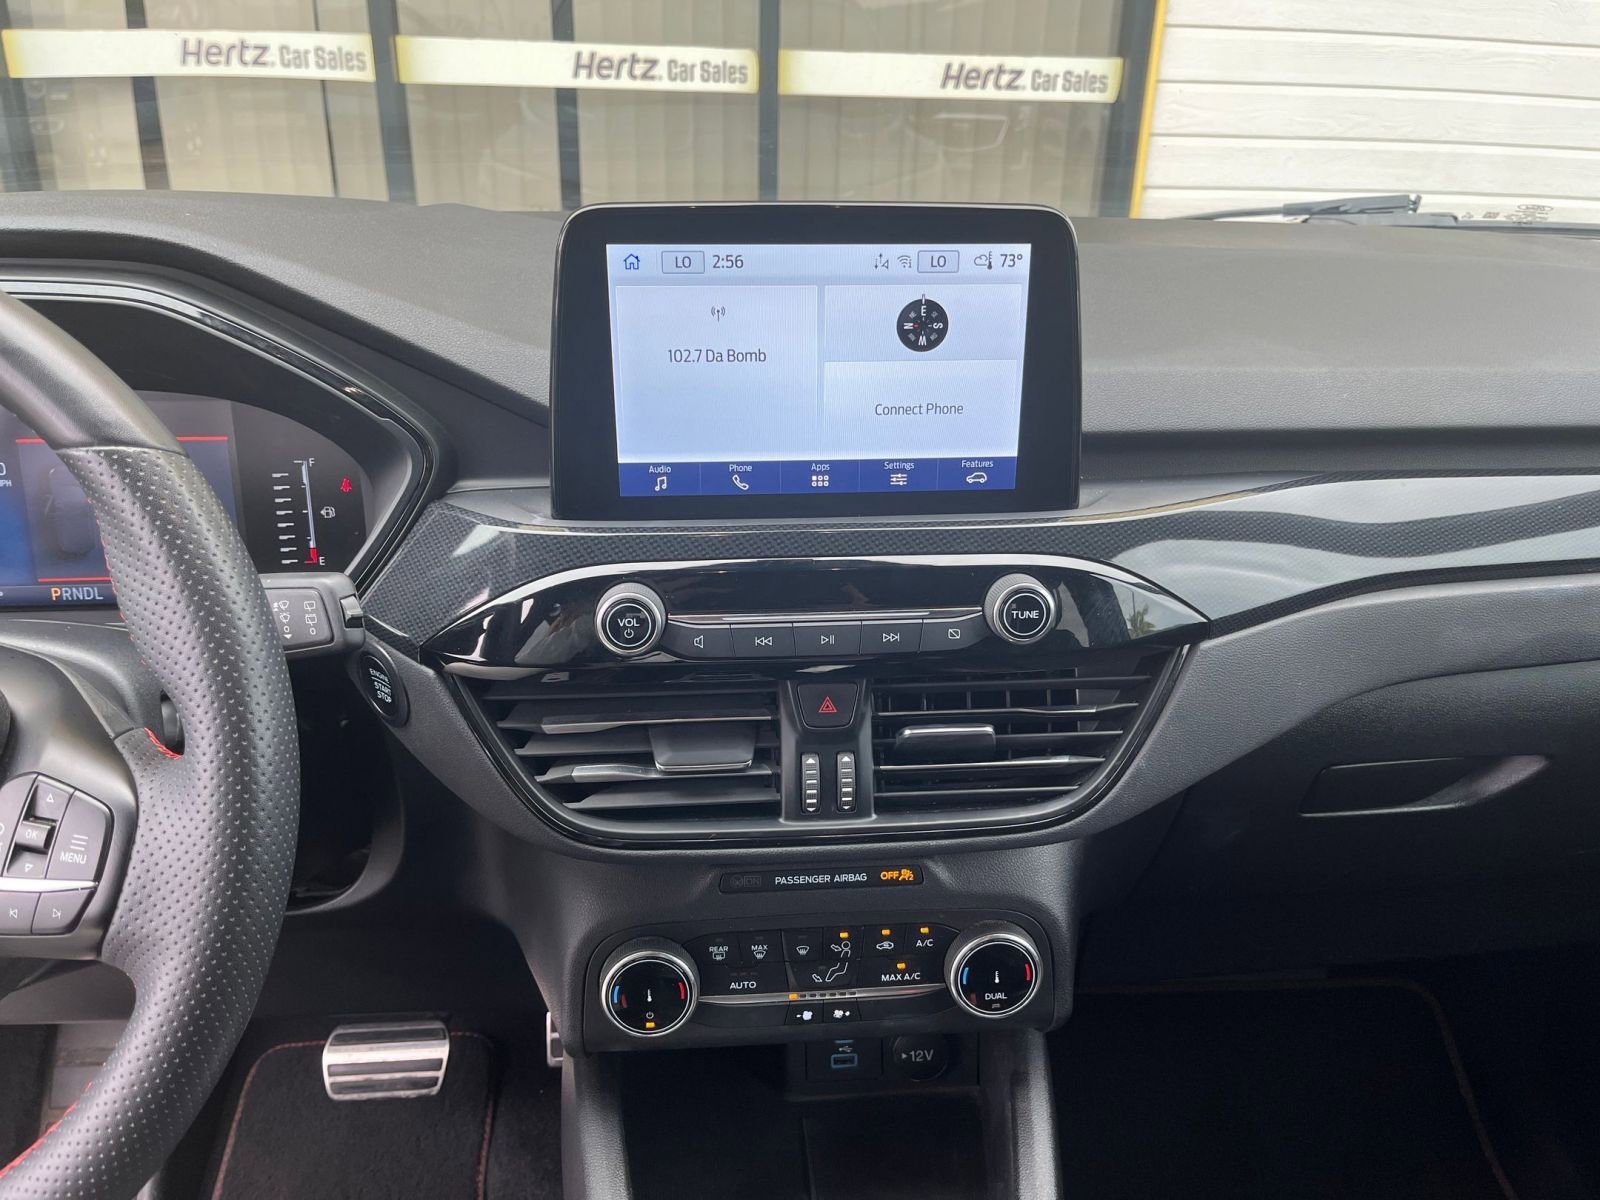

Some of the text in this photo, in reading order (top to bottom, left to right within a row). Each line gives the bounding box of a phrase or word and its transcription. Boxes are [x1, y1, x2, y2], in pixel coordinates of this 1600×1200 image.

[279, 44, 312, 69] Car
[314, 46, 367, 72] Sales
[667, 59, 698, 82] Car
[699, 60, 748, 84] Sales
[1031, 69, 1059, 92] Car
[1061, 70, 1109, 93] Sales
[675, 255, 692, 269] LO
[712, 254, 744, 269] 2:56
[930, 255, 947, 268] LO
[1000, 253, 1023, 268] 73°
[920, 305, 927, 316] E
[668, 348, 767, 363] 102.7 Da Bomb
[875, 402, 964, 416] Connect Phone
[308, 457, 315, 467] F
[728, 463, 753, 472] Phone
[811, 463, 830, 471] Apps
[883, 461, 915, 470] Settings
[961, 460, 994, 468] Features
[648, 465, 672, 473] Audio
[319, 556, 326, 565] E
[51, 587, 103, 601] PRNDL
[1011, 610, 1040, 619] TUNE
[617, 618, 640, 627] VOL
[374, 681, 392, 696] START
[377, 690, 392, 703] STOP
[25, 829, 39, 840] OK
[60, 851, 87, 864] MENU
[775, 873, 867, 885] PASSENGER AIRBAG
[880, 871, 899, 880] OFF
[916, 939, 934, 947] A/C
[881, 972, 921, 982] MAX A/C
[730, 981, 757, 989] AUTO
[985, 992, 1008, 1000] DUAL
[909, 1049, 934, 1062] 12V
